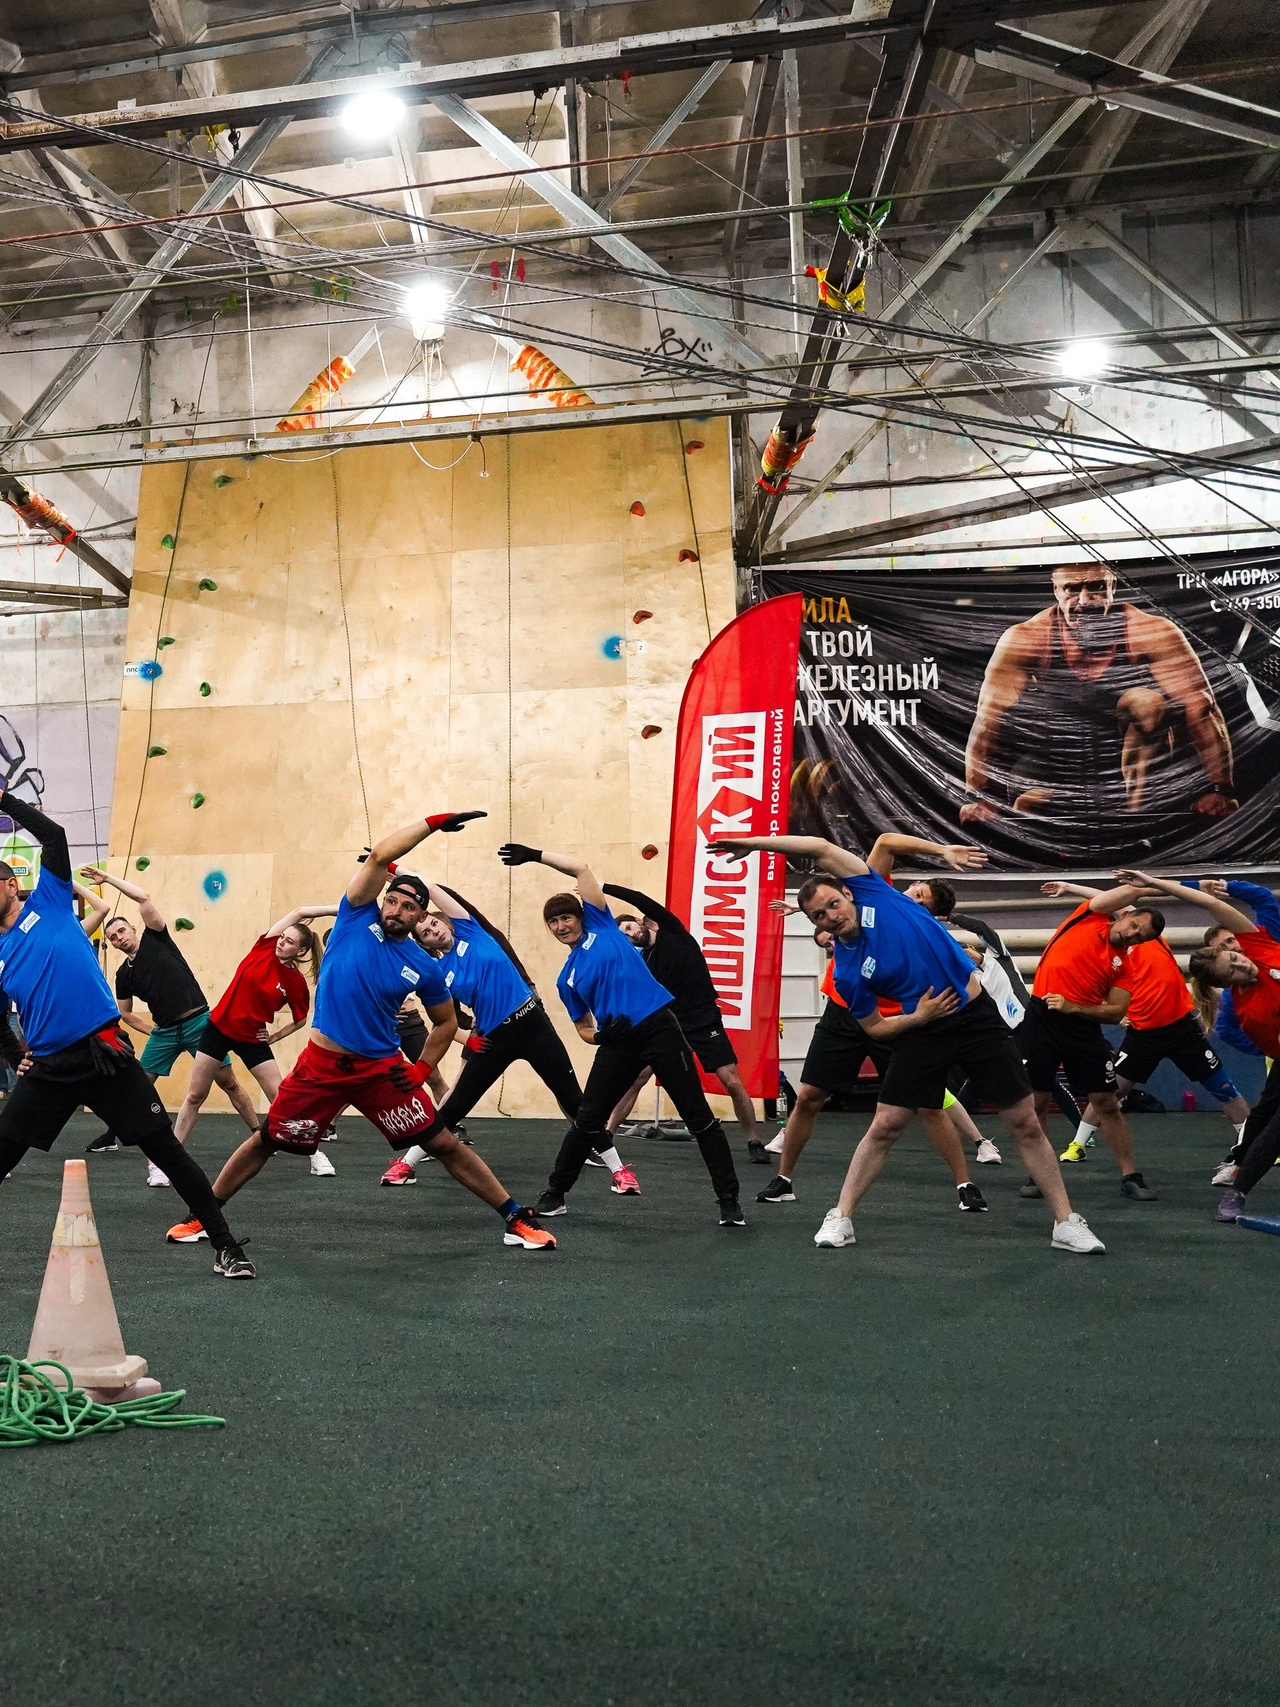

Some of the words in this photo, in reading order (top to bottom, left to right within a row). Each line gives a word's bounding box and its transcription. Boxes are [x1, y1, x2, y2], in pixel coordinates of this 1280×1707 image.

[1211, 567, 1280, 587] «АГОРА»
[802, 596, 853, 623] ИЛА
[806, 624, 874, 657] ТВОЙ
[796, 656, 939, 692] ЖЕЛЕЗНЫЙ
[793, 698, 922, 727] АРГУМЕНТ
[770, 708, 784, 814] поколений
[515, 999, 537, 1020] NIKE
